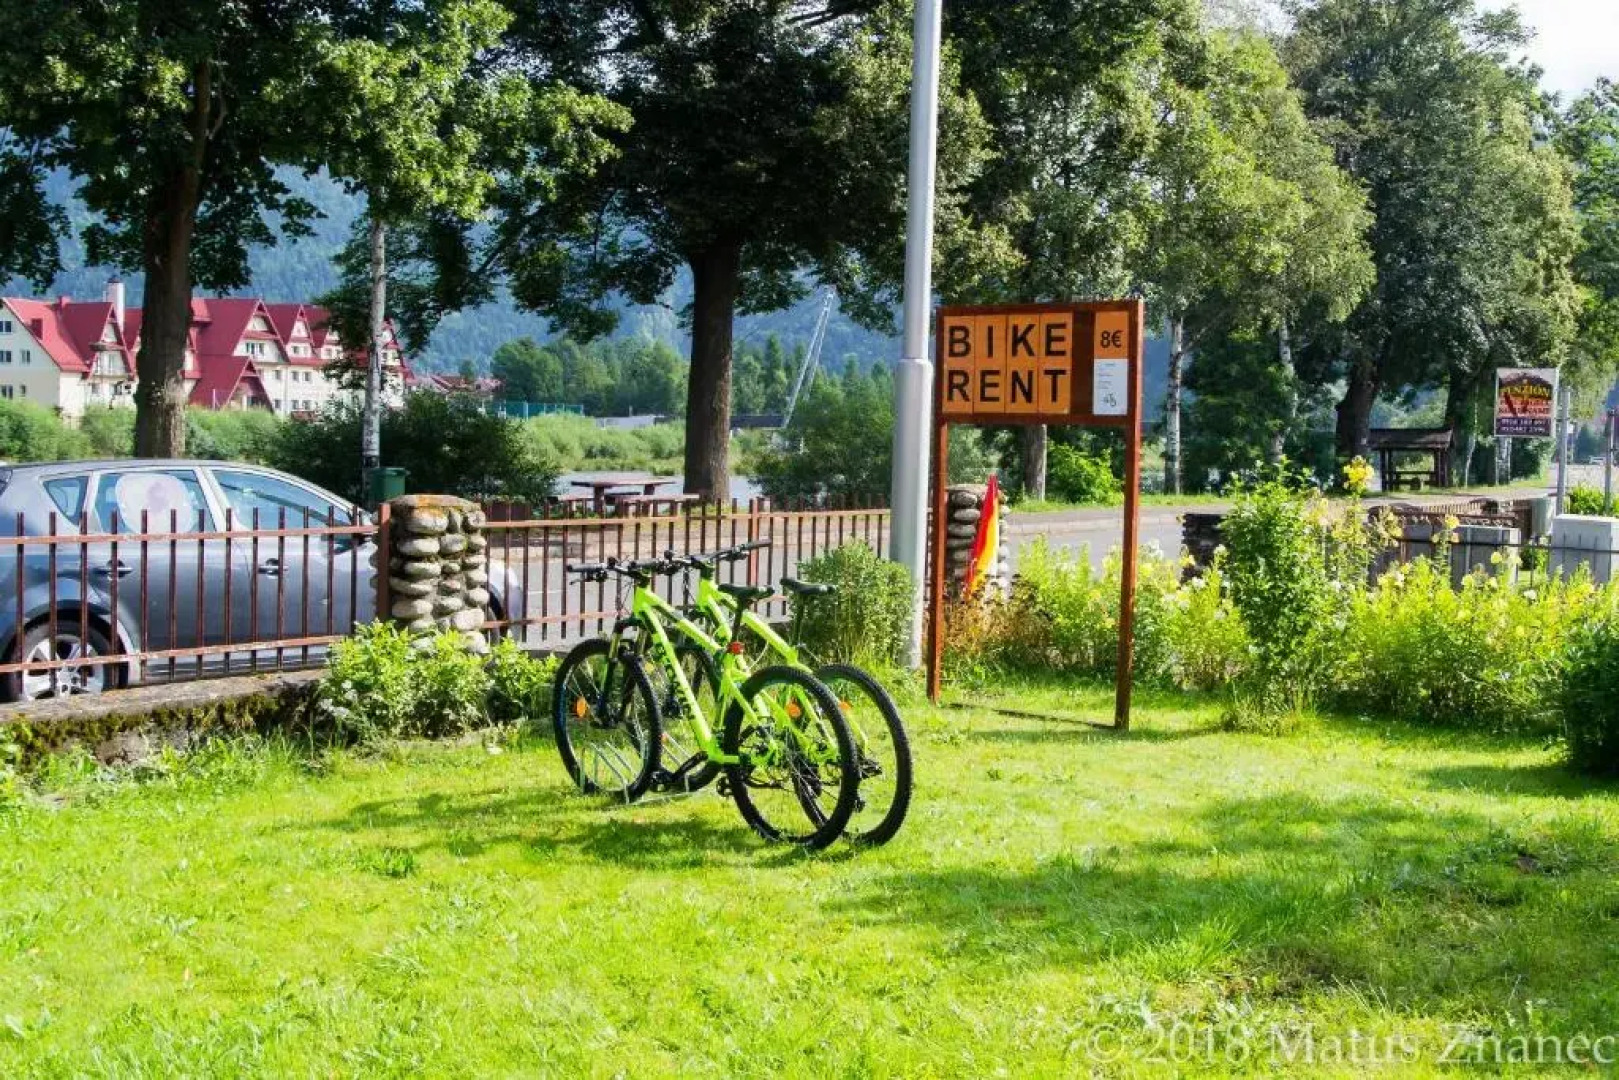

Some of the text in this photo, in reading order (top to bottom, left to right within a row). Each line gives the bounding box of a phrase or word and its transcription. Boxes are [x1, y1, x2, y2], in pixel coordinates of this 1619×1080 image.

[948, 323, 1067, 358] BIKE
[1100, 330, 1124, 349] 8€
[946, 369, 1067, 404] RENT
